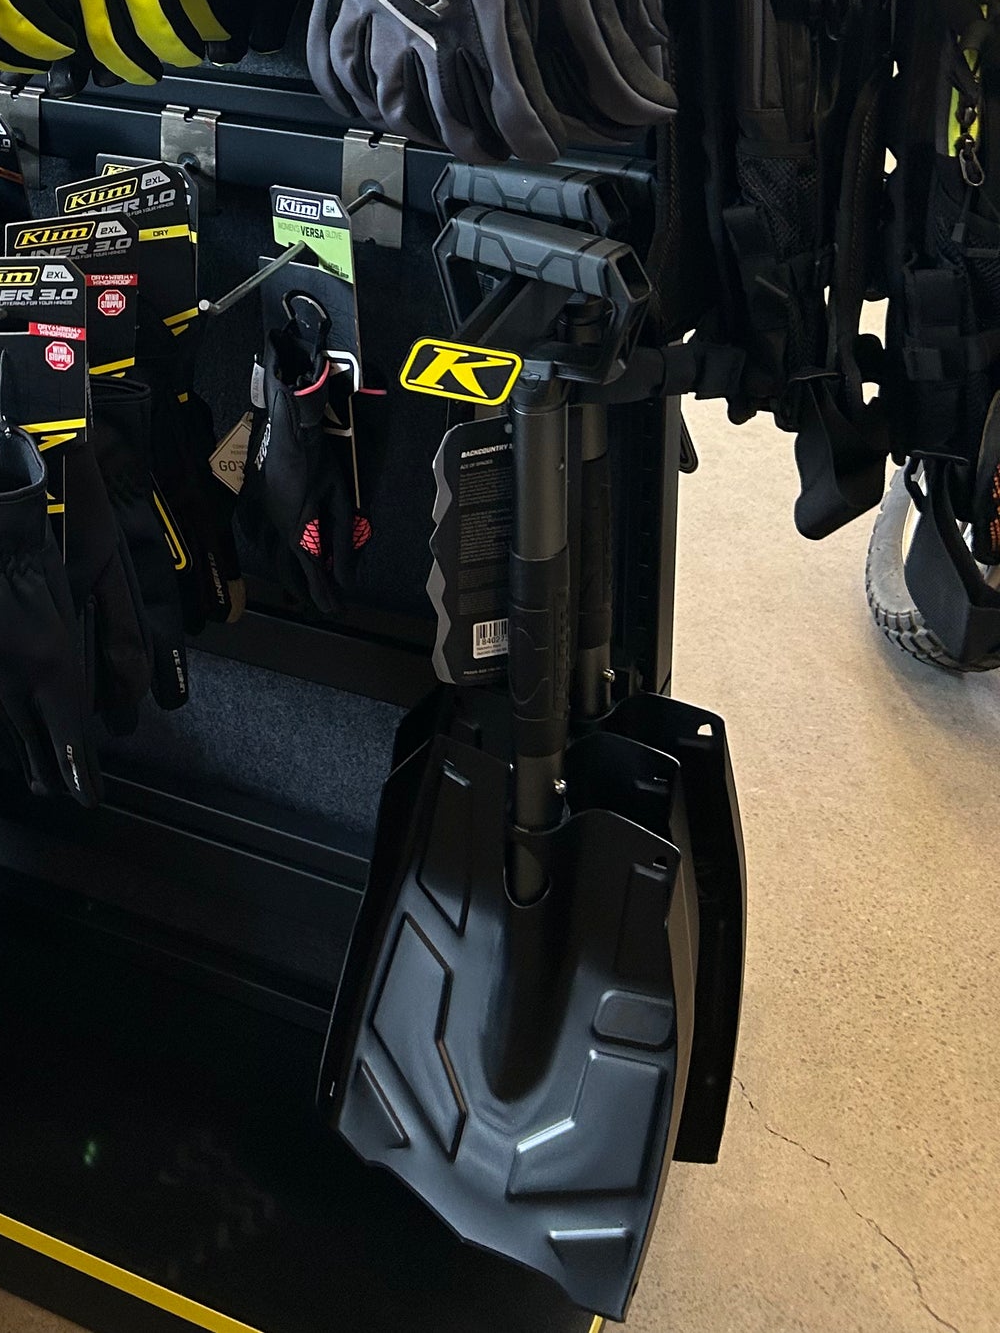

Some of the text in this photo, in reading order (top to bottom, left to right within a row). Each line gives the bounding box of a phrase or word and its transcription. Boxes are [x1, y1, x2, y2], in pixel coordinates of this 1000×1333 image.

[147, 189, 176, 204] 1.0
[153, 229, 168, 237] DRY
[301, 226, 324, 239] VERSA
[94, 238, 132, 252] 3.0
[39, 288, 78, 300] 3.0
[101, 300, 122, 309] STOPPER
[461, 445, 506, 459] BACKCOUNTRY
